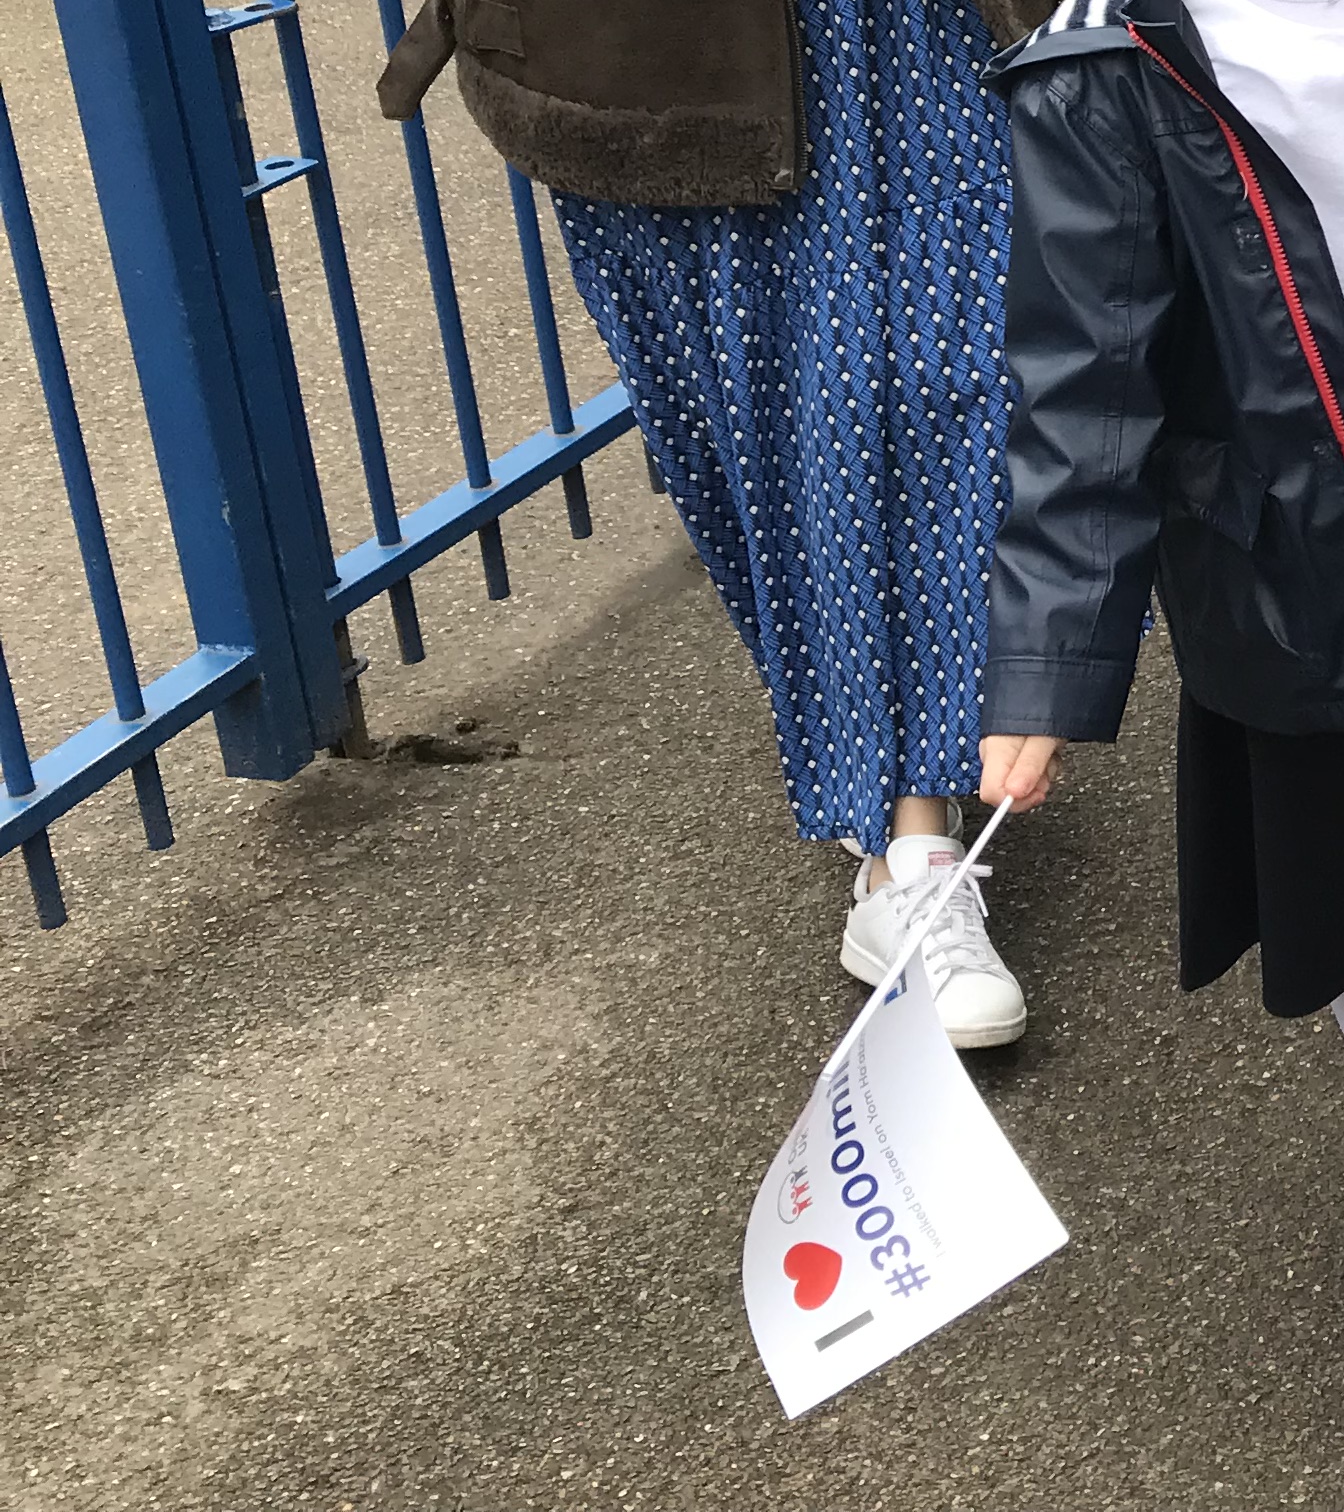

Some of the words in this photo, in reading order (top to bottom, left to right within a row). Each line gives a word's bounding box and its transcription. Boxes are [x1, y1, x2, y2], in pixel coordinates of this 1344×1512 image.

[863, 1092, 881, 1125] Yom
[873, 1124, 888, 1144] on
[879, 1145, 907, 1187] Israel
[902, 1185, 915, 1203] to
[907, 1198, 942, 1252] walked
[815, 1309, 875, 1353] I
